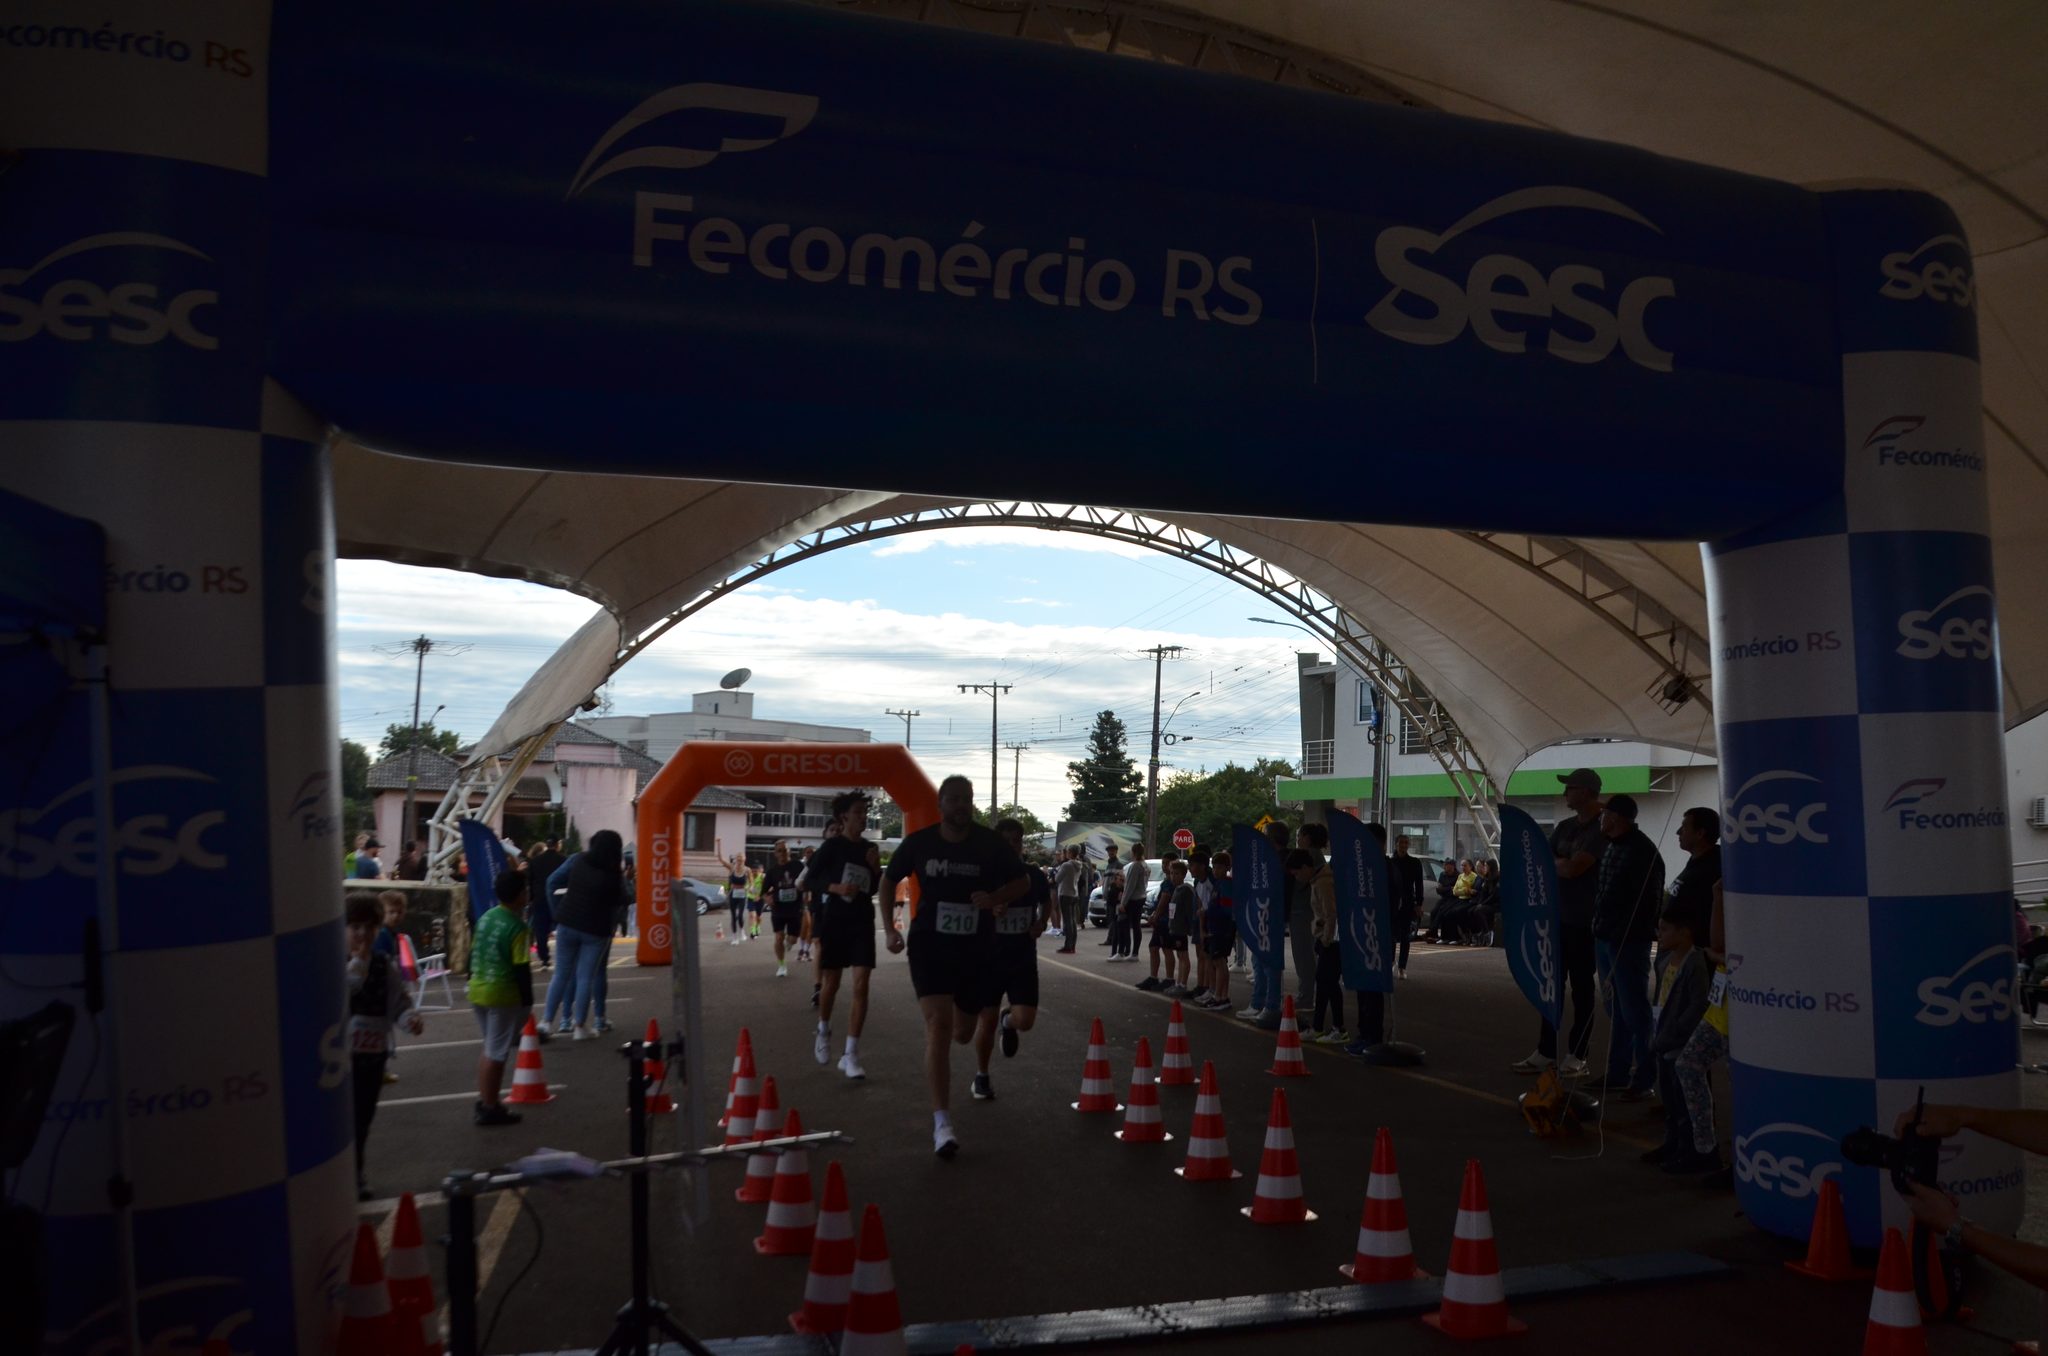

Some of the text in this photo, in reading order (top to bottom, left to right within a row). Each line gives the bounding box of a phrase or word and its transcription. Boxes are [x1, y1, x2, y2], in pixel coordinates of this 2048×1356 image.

[0, 23, 253, 78] comércio RS
[633, 190, 1264, 326] Fecomércio RS
[1878, 250, 1975, 308] Ses
[1364, 224, 1677, 373] Sesc
[203, 565, 249, 595] RS
[1807, 630, 1842, 652] RS
[762, 753, 870, 776] CRESOL
[1174, 835, 1193, 844] PARE
[651, 827, 672, 918] CRESOL
[942, 913, 974, 932] 210
[1001, 916, 1028, 931] 113
[1824, 991, 1861, 1014] RS
